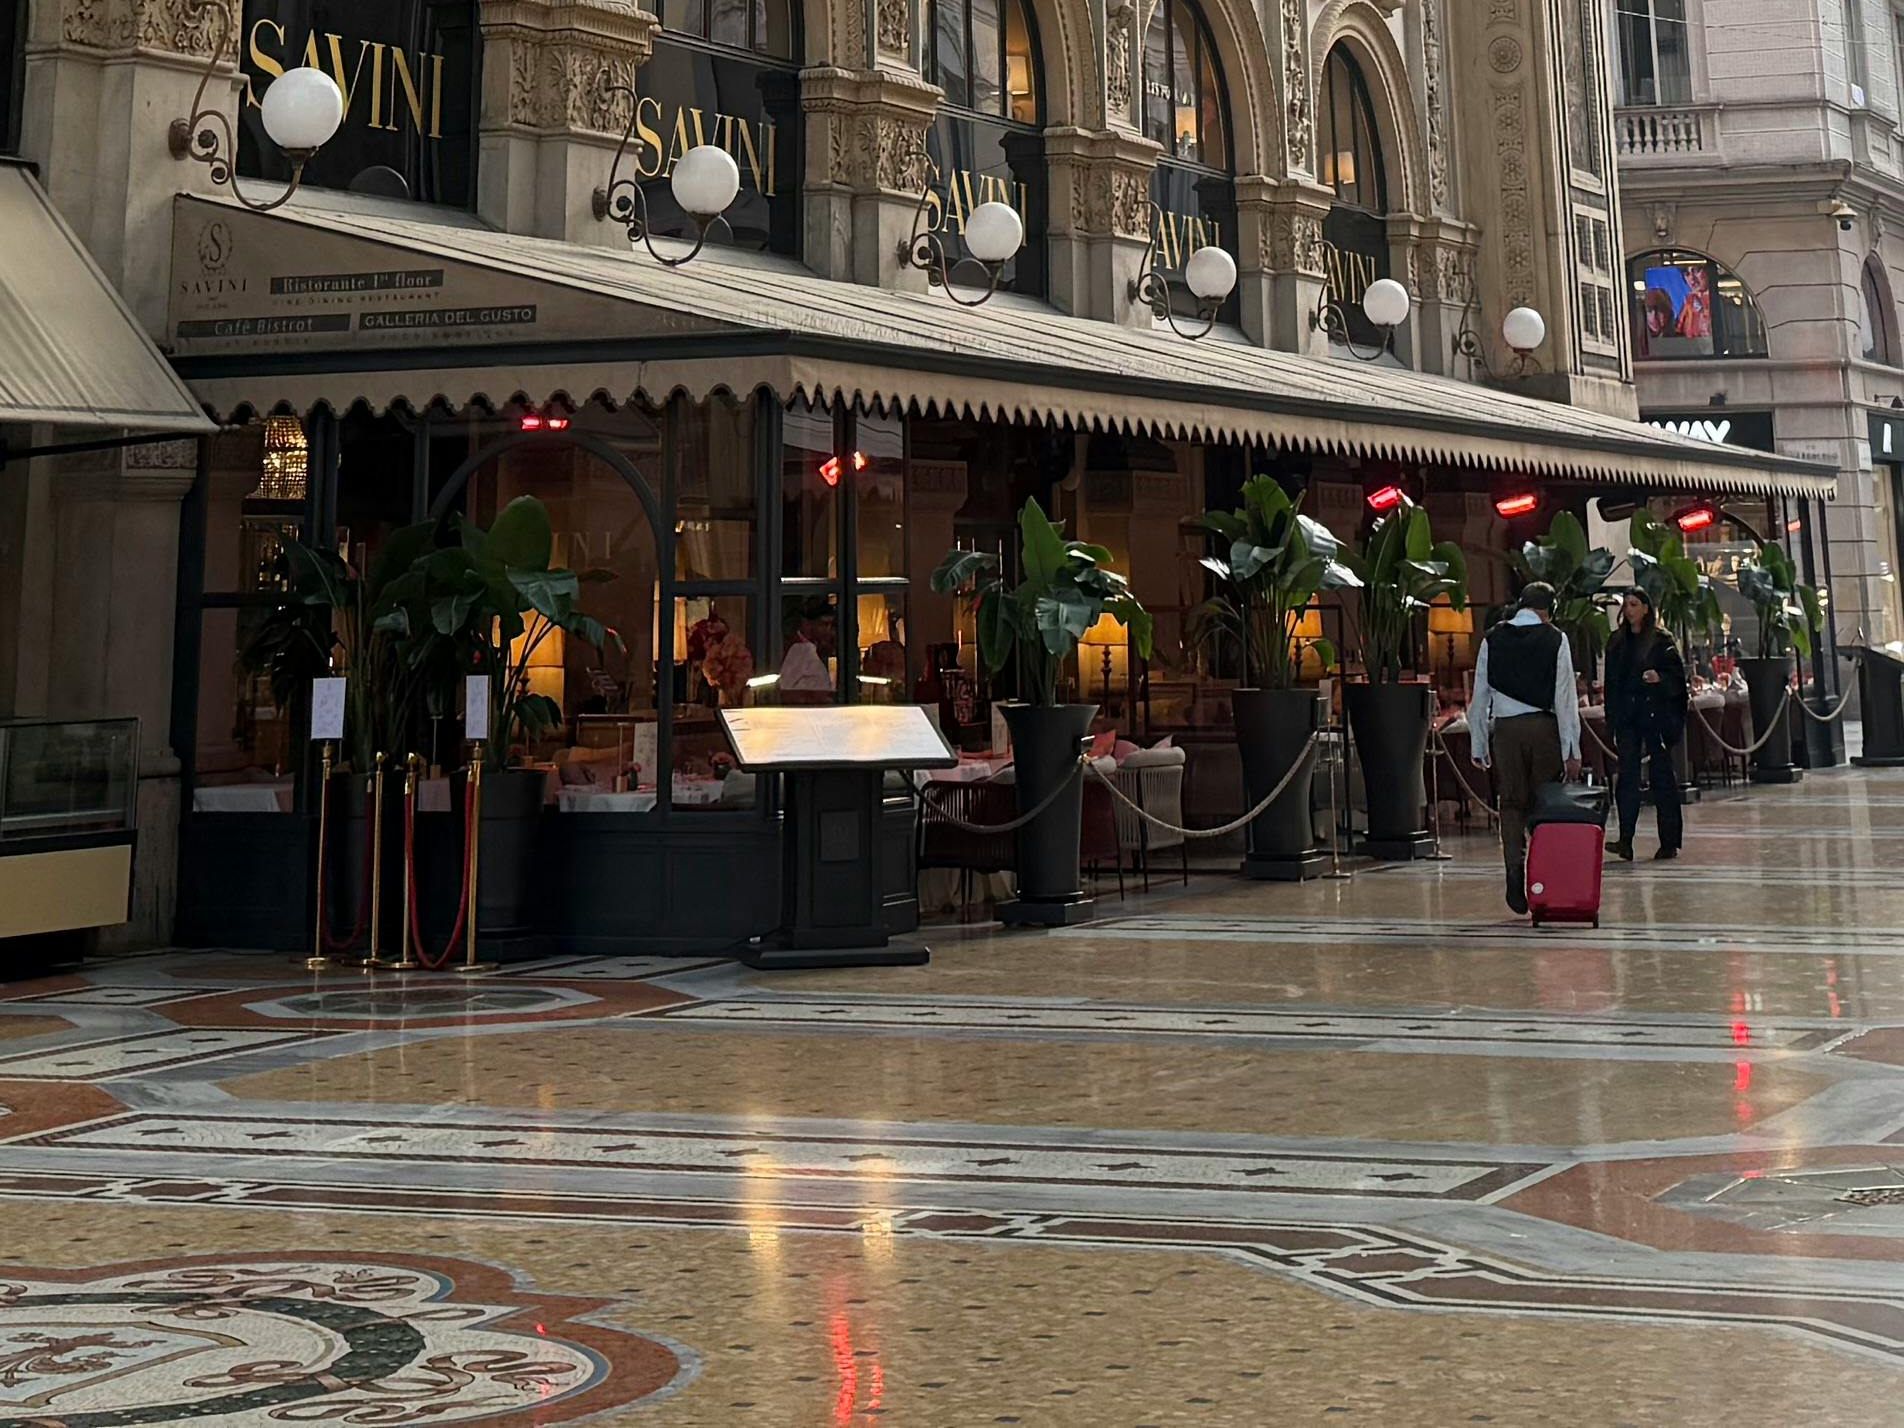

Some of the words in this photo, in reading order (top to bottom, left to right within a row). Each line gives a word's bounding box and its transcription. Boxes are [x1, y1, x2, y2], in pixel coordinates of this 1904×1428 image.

[180, 279, 248, 294] SAVINI
[283, 278, 365, 293] Ristorante
[395, 273, 432, 288] floor
[256, 318, 313, 333] Bistrot
[364, 312, 440, 327] GALLERIA
[445, 310, 475, 324] DEL
[480, 308, 532, 322] GUSTO
